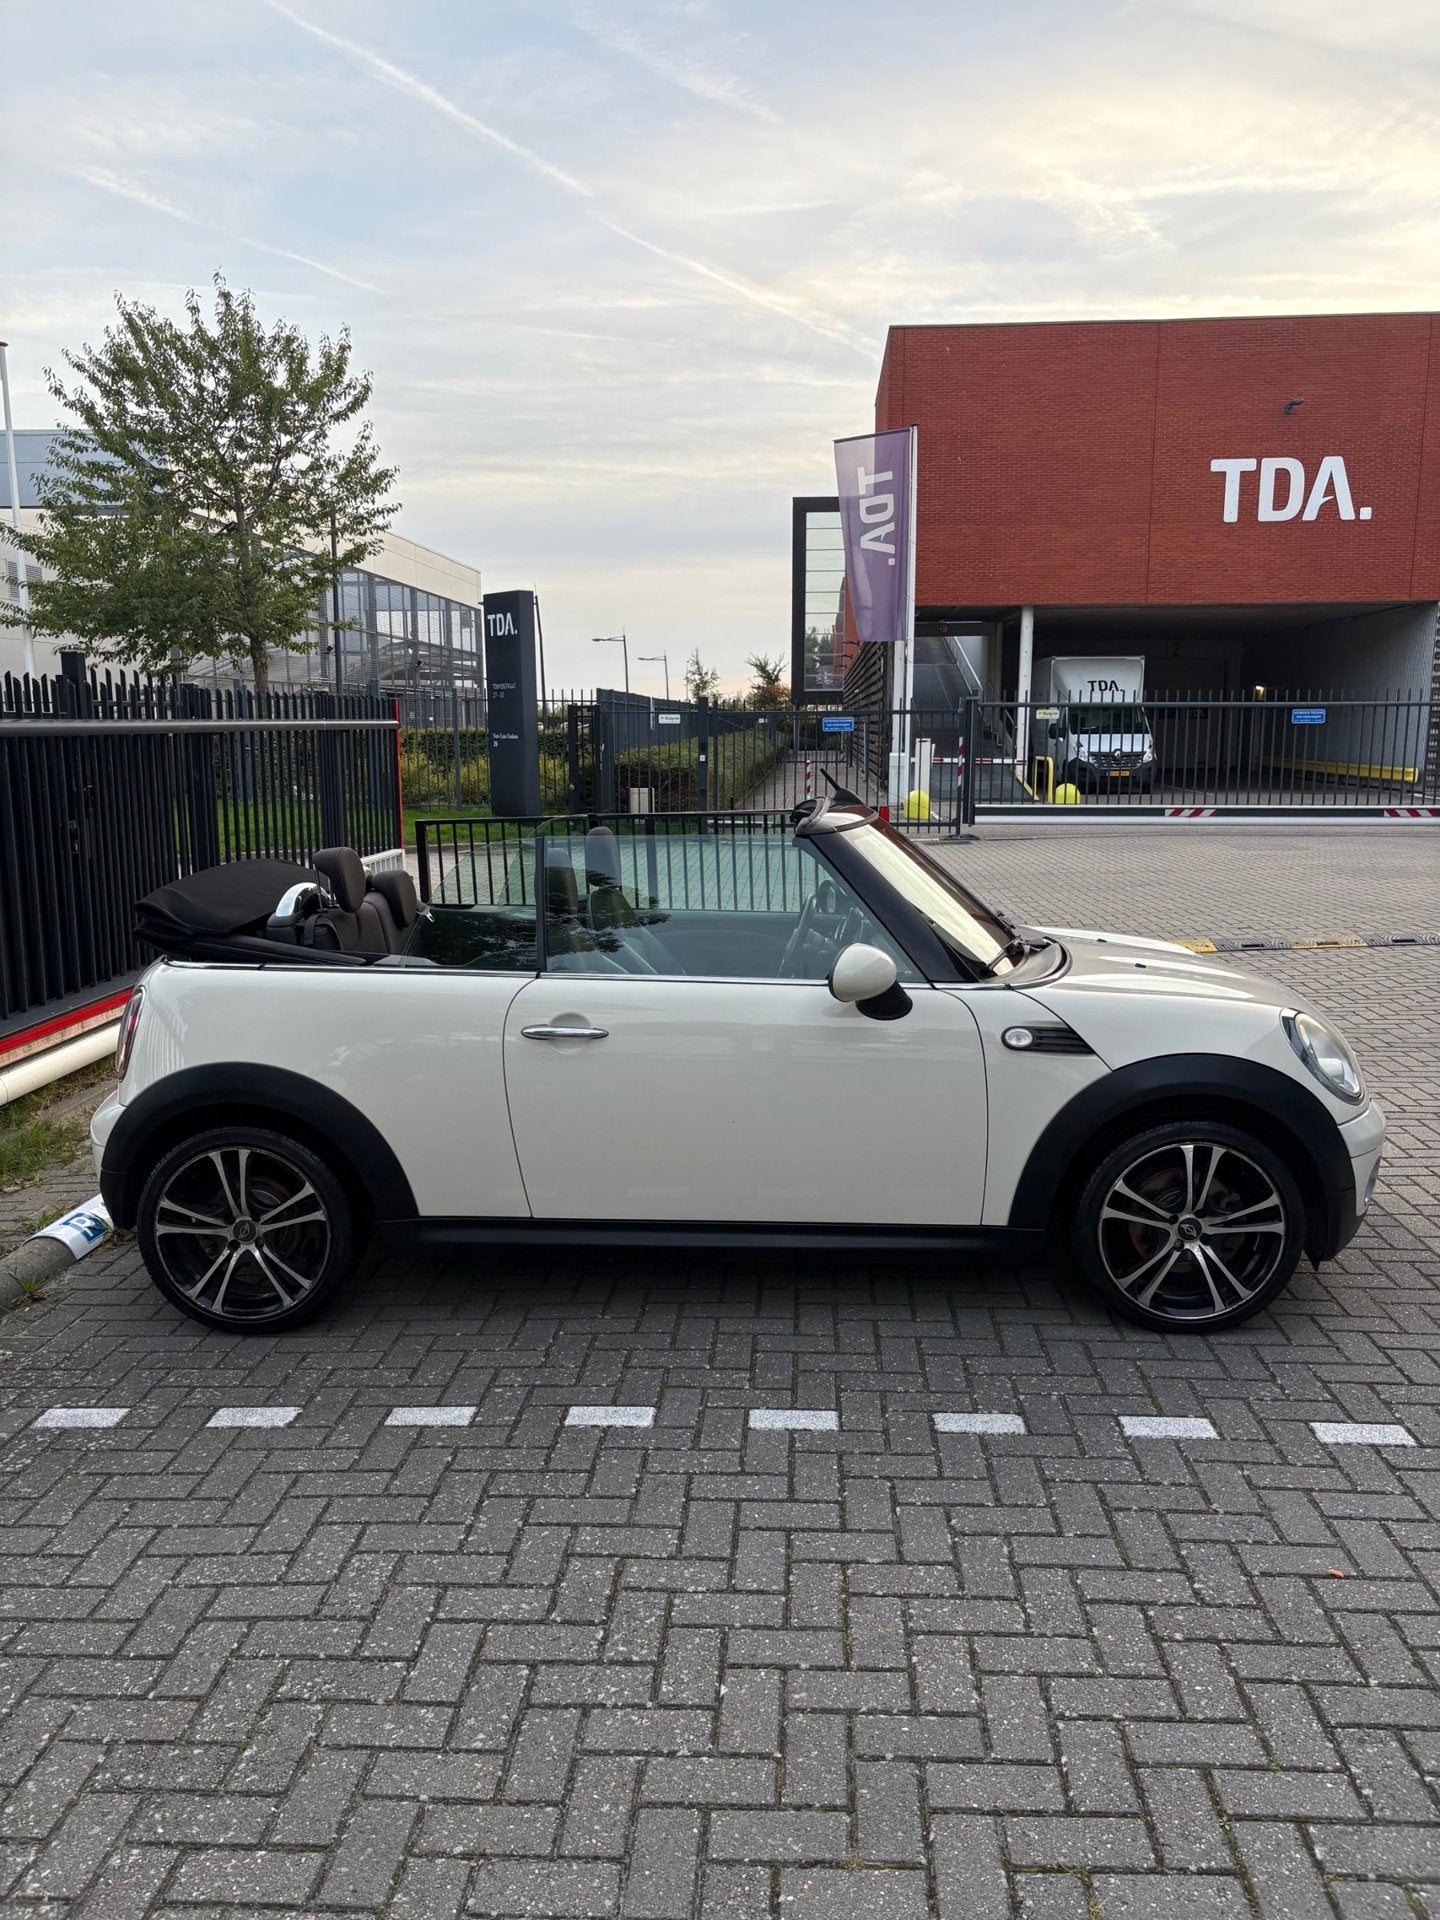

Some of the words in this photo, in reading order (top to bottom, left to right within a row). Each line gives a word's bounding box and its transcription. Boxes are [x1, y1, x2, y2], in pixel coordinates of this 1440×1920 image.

[857, 466, 896, 566] TDA.
[1210, 456, 1372, 523] TDA.
[487, 612, 518, 637] TDA.
